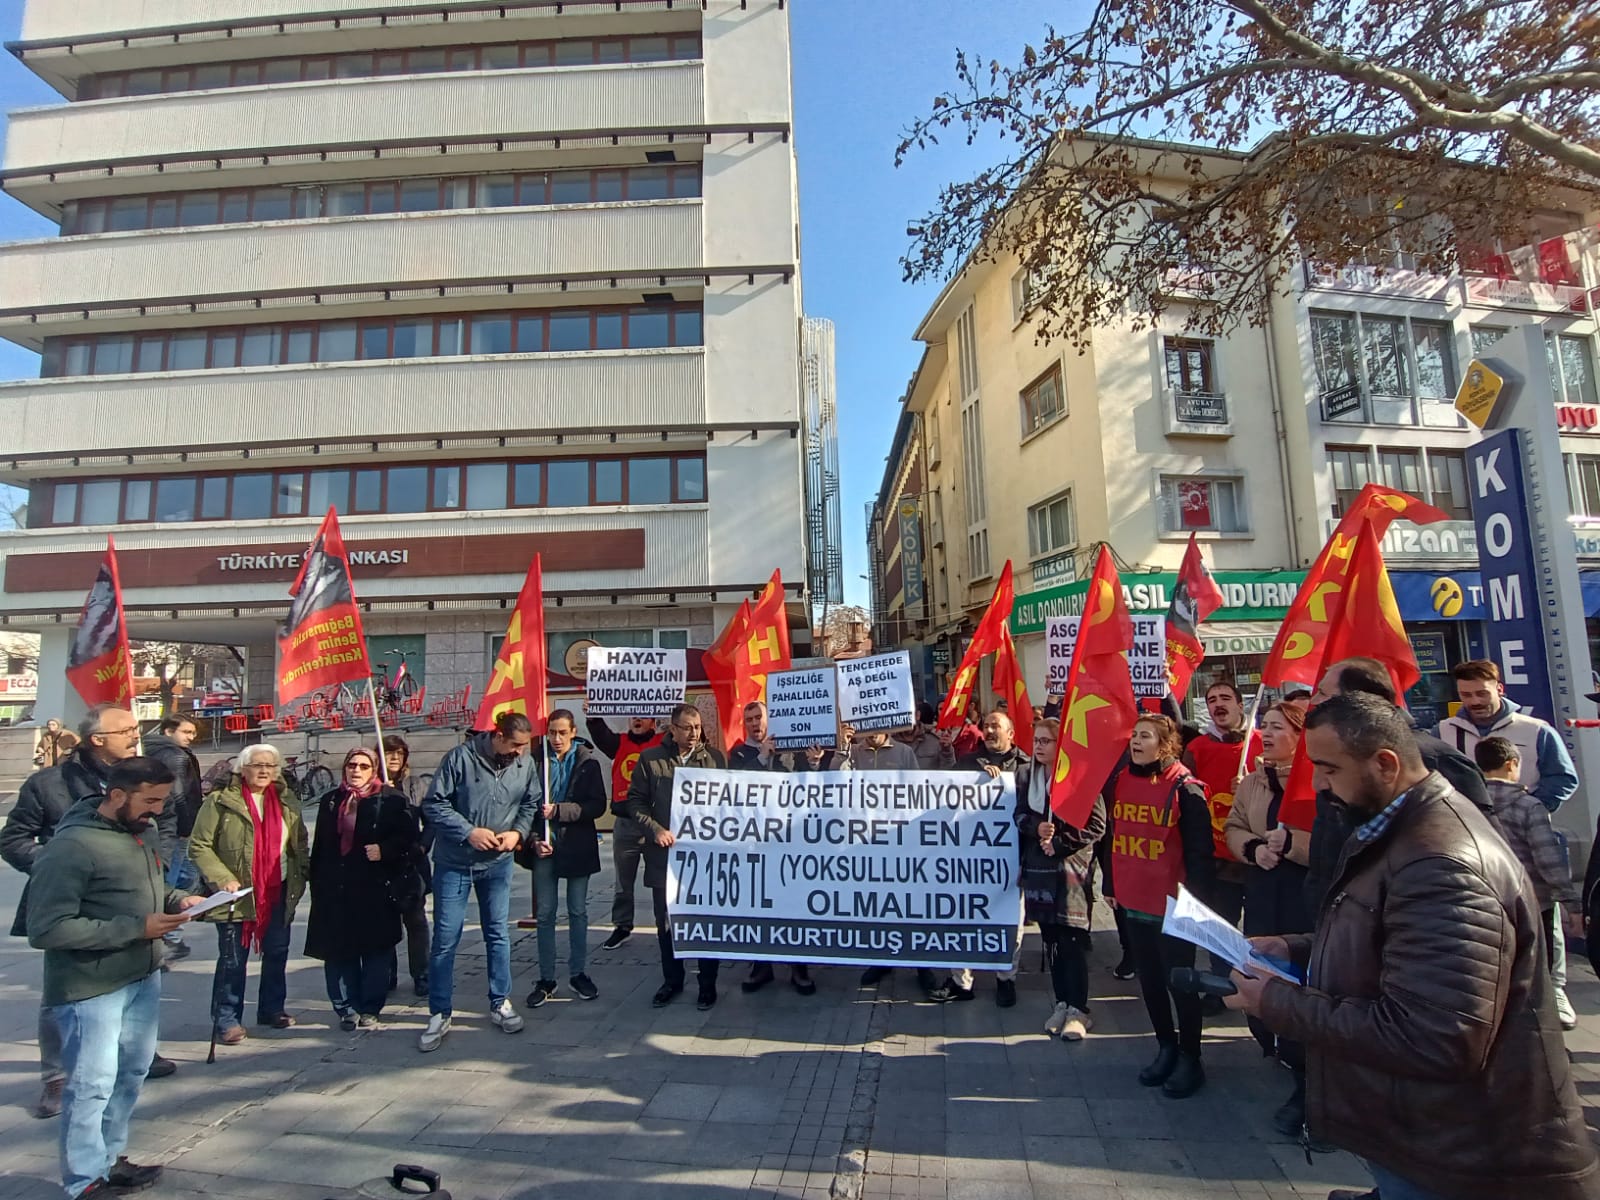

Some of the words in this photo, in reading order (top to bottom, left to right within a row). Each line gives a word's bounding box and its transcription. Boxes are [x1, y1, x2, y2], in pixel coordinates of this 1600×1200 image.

[217, 552, 299, 570] TÜRKİYE
[350, 549, 409, 565] NKASI
[903, 520, 920, 598] KOMEK
[1122, 584, 1171, 610] ASIL
[1219, 583, 1298, 608] NDURM
[1018, 604, 1036, 626] ASIL
[1038, 592, 1087, 623] DONDURM
[1050, 623, 1077, 638] ASG
[608, 652, 667, 664] HAYAT
[840, 656, 903, 673] TENCEREDE
[590, 667, 683, 682] PAHALILIĞINI
[777, 672, 824, 689] İŞSİZLİĞE
[848, 677, 861, 687] AŞ
[865, 670, 897, 684] DEĞİL
[588, 686, 683, 701] DURDURACAĞIZ
[772, 688, 829, 702] PAHALILIĞA
[860, 687, 888, 699] DERT
[1049, 682, 1066, 693] HAL
[1132, 682, 1164, 695] ARTİSİ
[587, 705, 614, 713] HALKIN
[615, 704, 655, 715] KURTULUŞ
[655, 704, 676, 713] PART
[769, 708, 796, 718] ZAMA
[798, 705, 833, 716] ZULME
[852, 701, 899, 716] PİŞİYOR!
[790, 722, 812, 732] SON
[679, 779, 773, 807] SEFALET
[777, 779, 853, 808] ÜCRETİ
[860, 779, 1006, 811] İSTEMİYORUZ
[676, 813, 792, 843] ASGARİ
[803, 814, 910, 846] ÜCRET
[920, 821, 960, 847] EN
[970, 821, 1013, 847] AZ
[1112, 834, 1166, 861] HKP
[674, 851, 740, 908] 72.156
[746, 853, 773, 909] TL
[780, 853, 929, 887] (YOKSULLUK
[935, 857, 1010, 891] SINIRI)
[807, 890, 991, 921] OLMALIDIR
[673, 922, 762, 945] HALKIN
[769, 926, 904, 955] KURTULUŞ
[911, 929, 1008, 954] PARTİSİ
